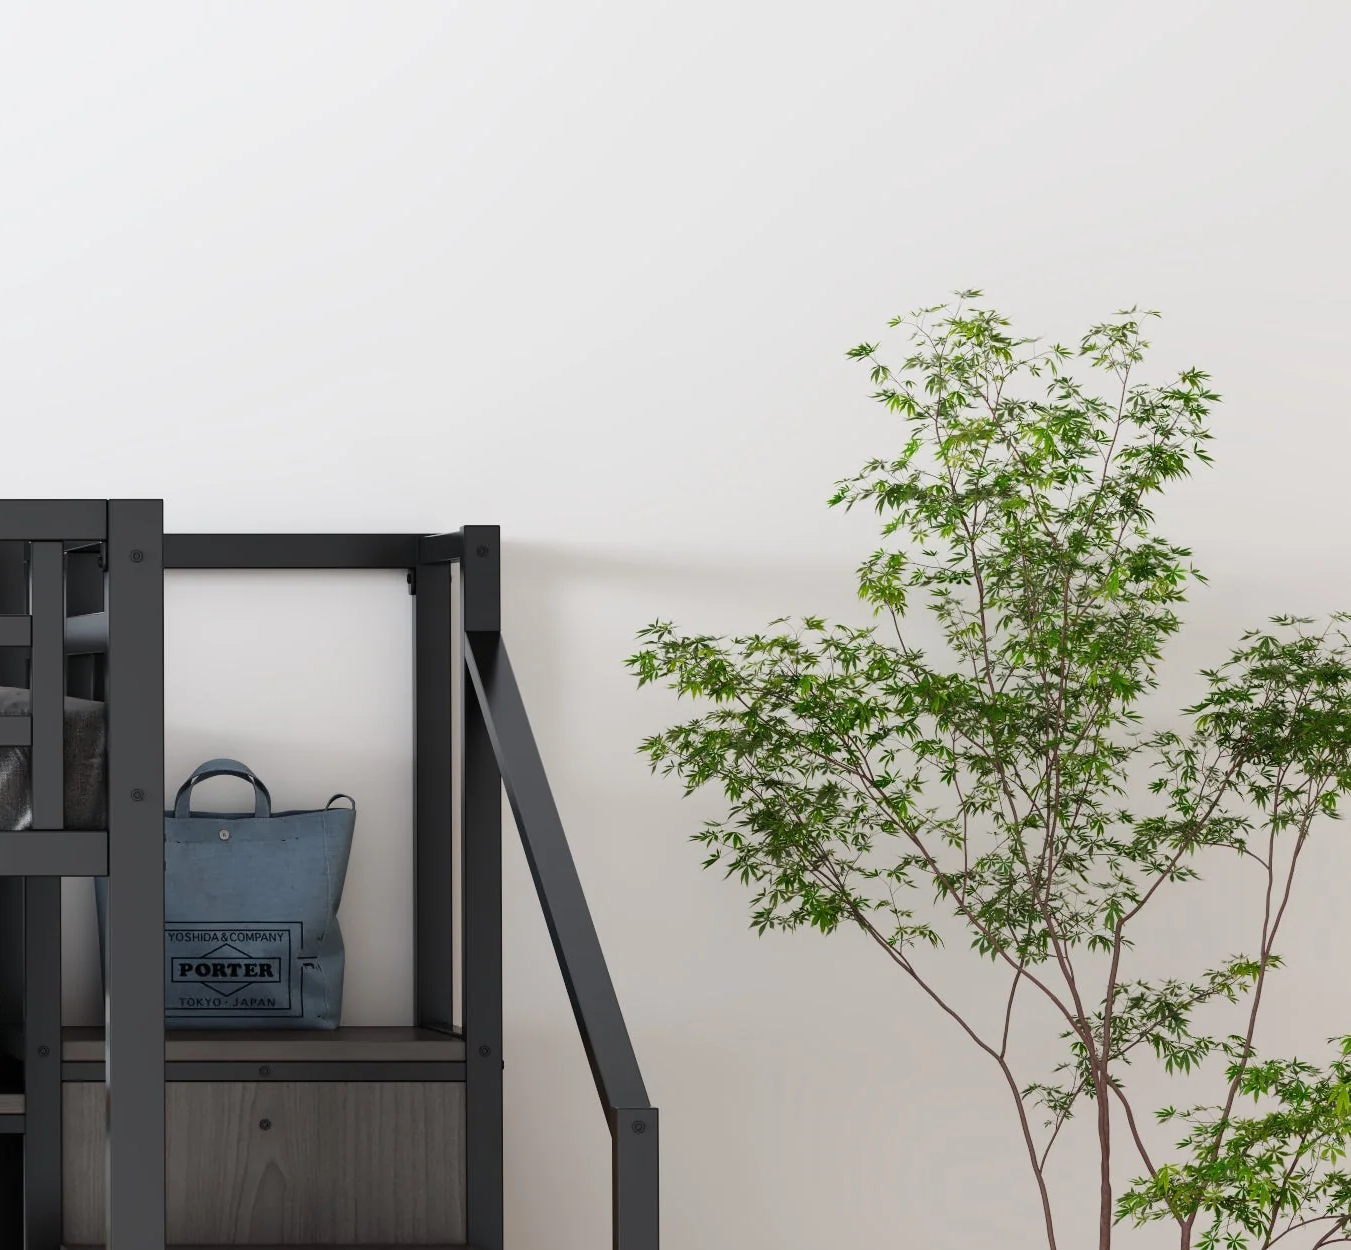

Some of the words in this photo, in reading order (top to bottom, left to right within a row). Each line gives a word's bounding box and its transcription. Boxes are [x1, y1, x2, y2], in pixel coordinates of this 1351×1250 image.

[168, 932, 218, 942] YOSHIDA
[230, 932, 284, 942] COMPANY
[179, 962, 274, 978] PORTER
[179, 997, 221, 1007] TOKYO
[232, 997, 276, 1007] JAPAN
